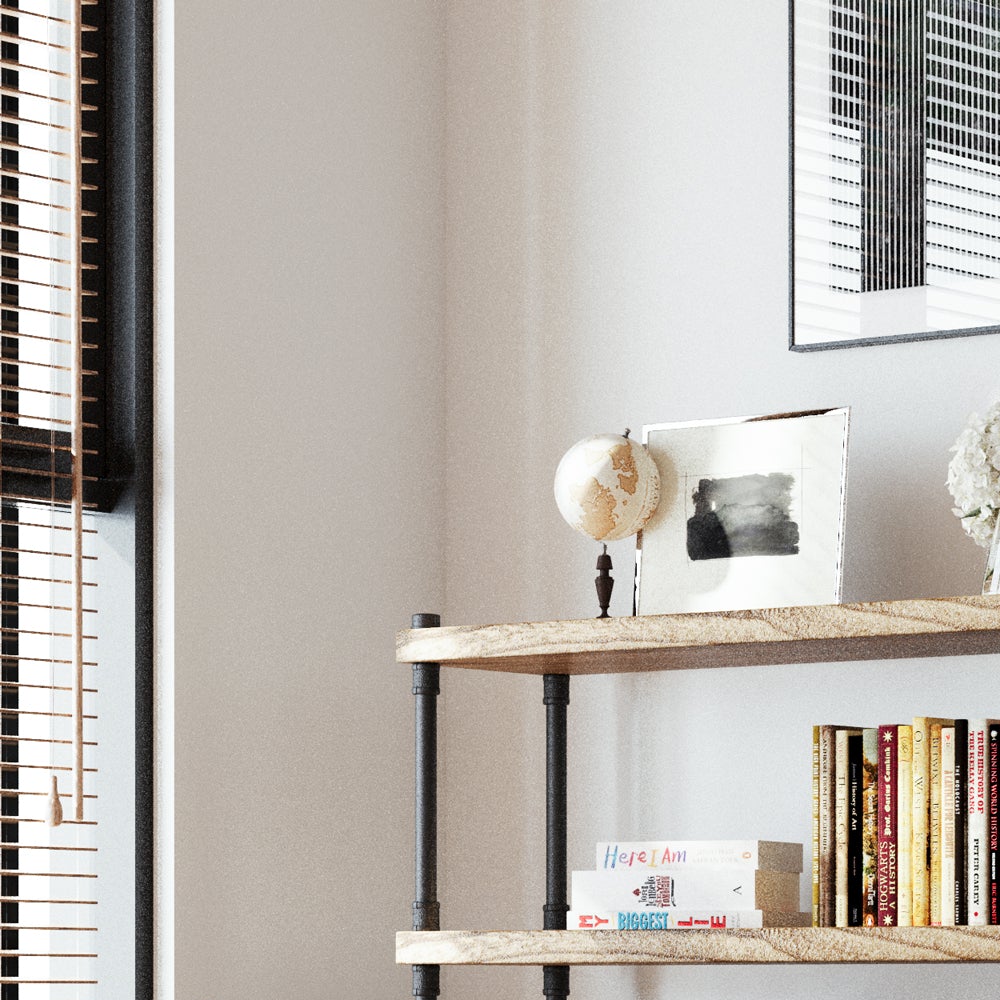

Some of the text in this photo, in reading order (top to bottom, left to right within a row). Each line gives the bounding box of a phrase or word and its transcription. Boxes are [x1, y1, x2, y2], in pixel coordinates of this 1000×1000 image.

[977, 801, 984, 814] OF
[990, 743, 998, 851] SPINNING WORLD HISTORY
[604, 845, 647, 869] Here
[648, 849, 659, 868] I
[661, 846, 687, 864] Am
[578, 912, 727, 930] MY BIGGEST LIE
